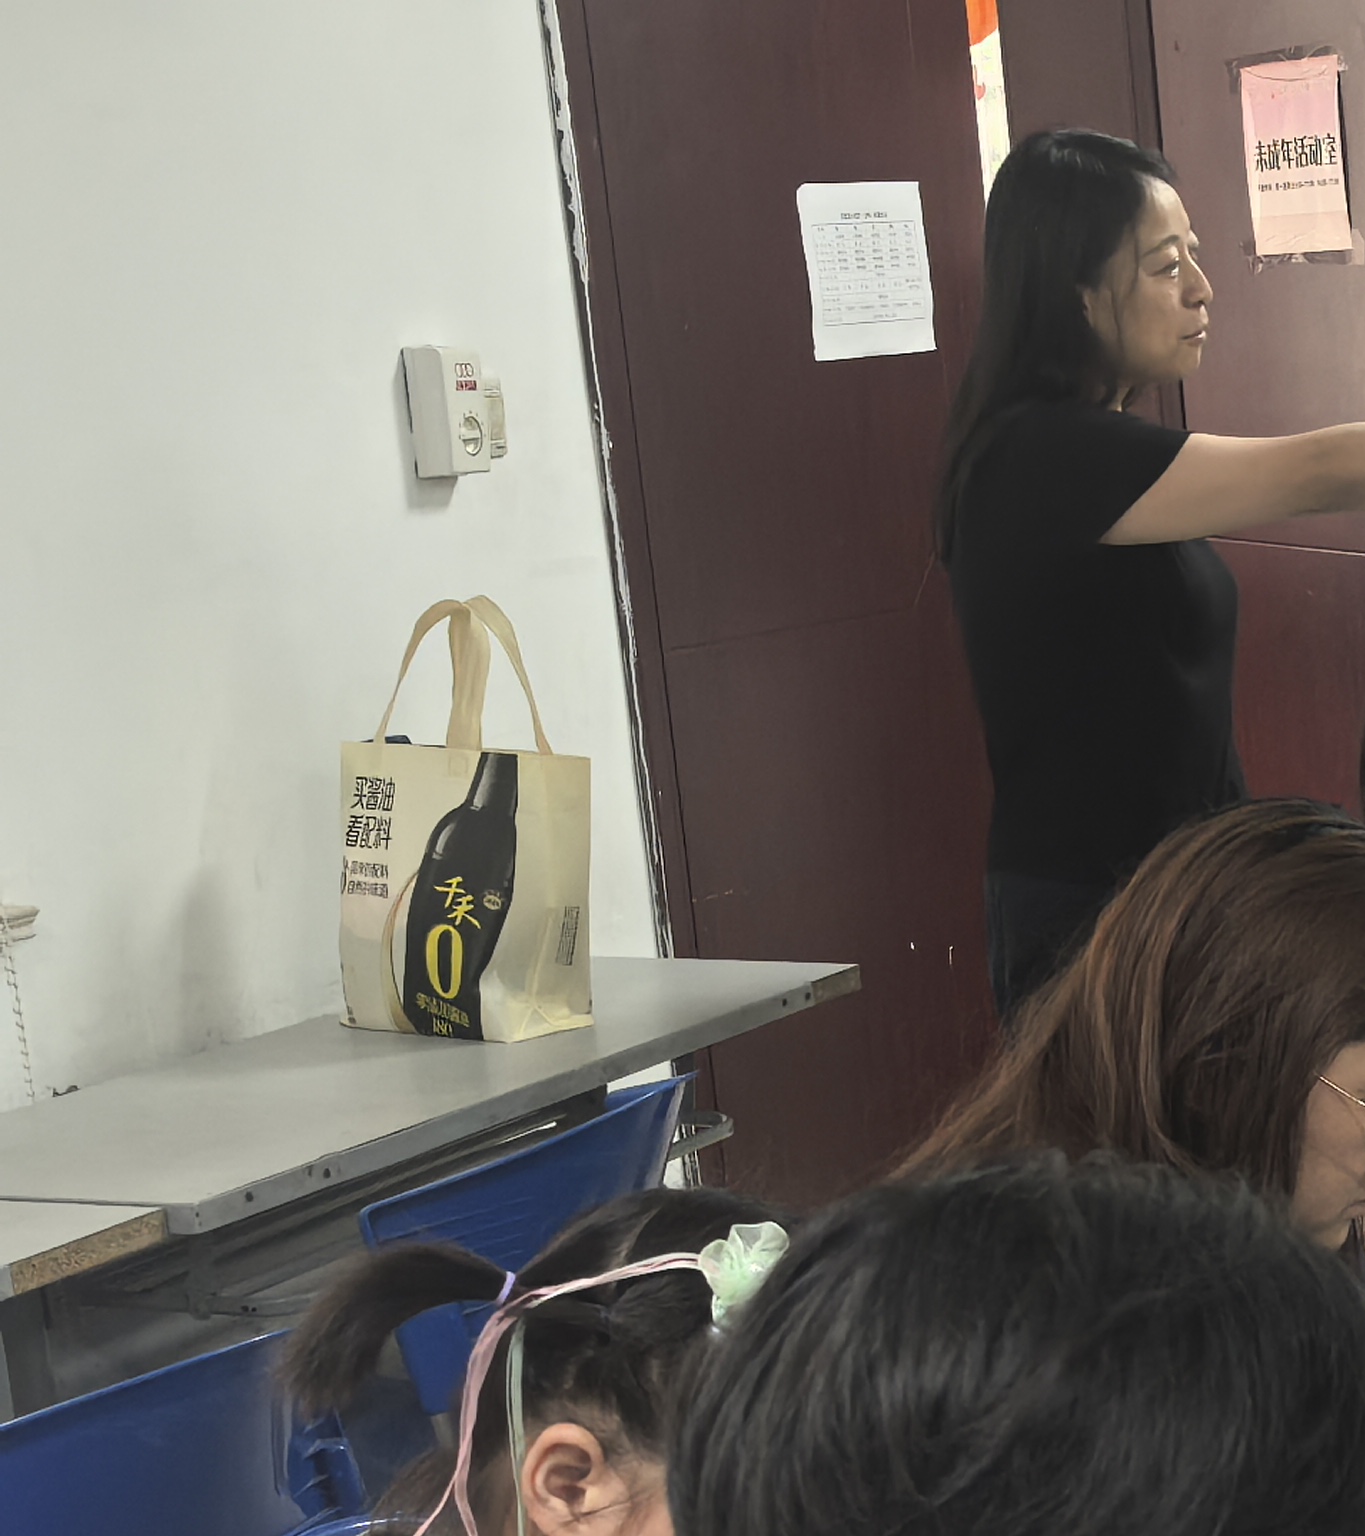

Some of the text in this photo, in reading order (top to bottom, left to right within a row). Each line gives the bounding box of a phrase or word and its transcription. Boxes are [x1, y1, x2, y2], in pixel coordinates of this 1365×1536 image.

[1254, 133, 1338, 172] 未成年活动室
[350, 776, 396, 812] 买酱油
[345, 815, 392, 850] 看配料
[433, 876, 482, 930] 千禾
